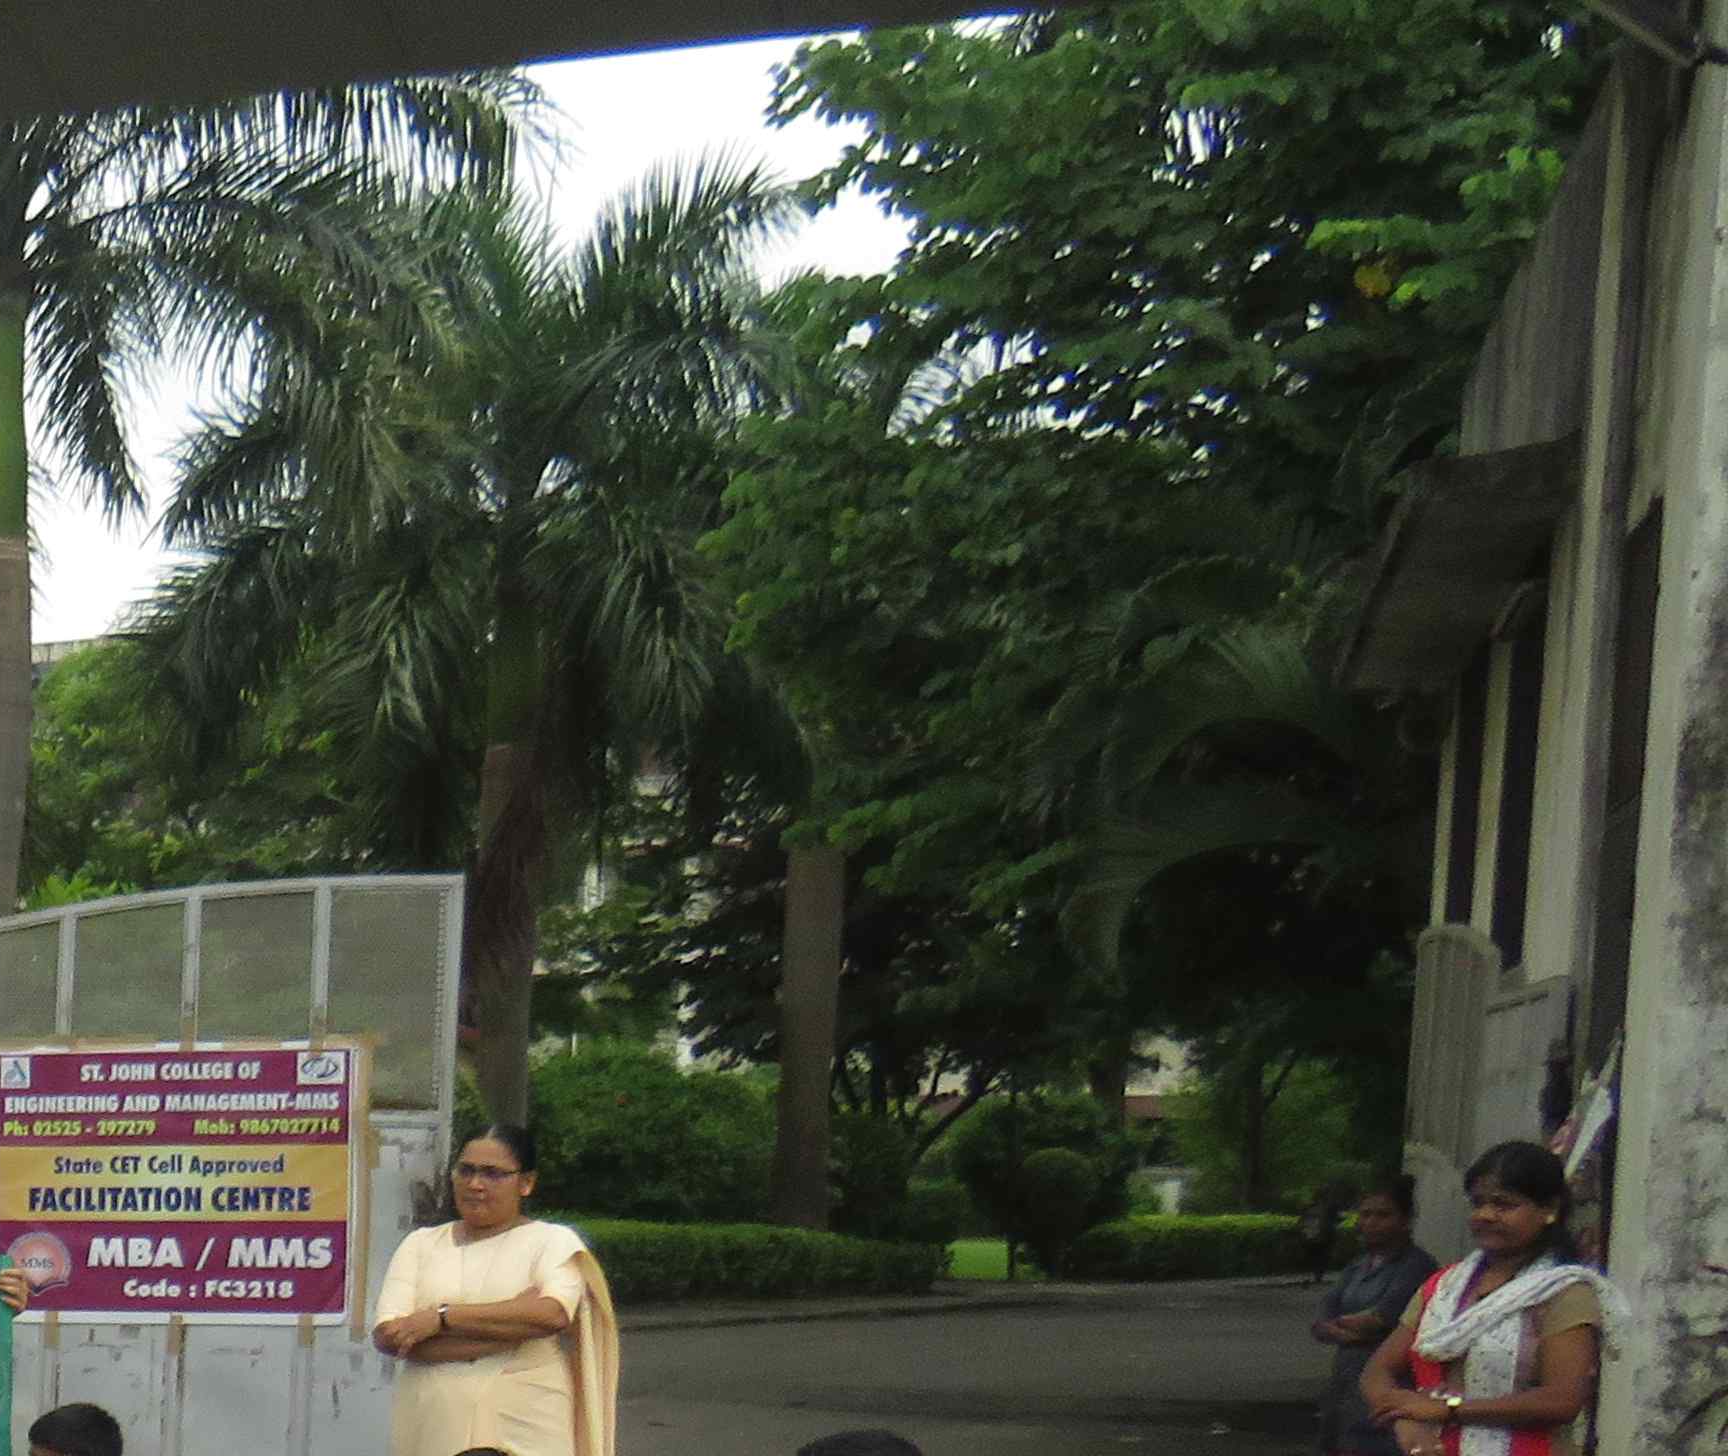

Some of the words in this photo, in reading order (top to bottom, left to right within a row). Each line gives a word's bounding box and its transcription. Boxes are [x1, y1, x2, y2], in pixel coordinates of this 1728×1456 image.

[80, 1063, 105, 1082] ST.
[109, 1063, 156, 1082] JOHN
[159, 1062, 232, 1081] COLLEGE
[237, 1061, 262, 1080] OF
[4, 1095, 118, 1114] ENGINEERING
[122, 1095, 160, 1112] AND
[164, 1092, 340, 1113] MANAGEMENT-MMS
[3, 1119, 28, 1136] Ph:
[32, 1120, 82, 1137] 02525
[193, 1119, 235, 1136] Mob:
[54, 1155, 104, 1175] State
[109, 1155, 142, 1174] CET
[148, 1154, 183, 1174] Cell
[189, 1153, 284, 1178] Approved
[28, 1187, 202, 1212] FACILITATION
[211, 1186, 312, 1212] CENTRE
[87, 1237, 185, 1268] MBA
[227, 1237, 333, 1269] MMS
[123, 1279, 182, 1298] Code
[204, 1279, 294, 1299] FC3218
